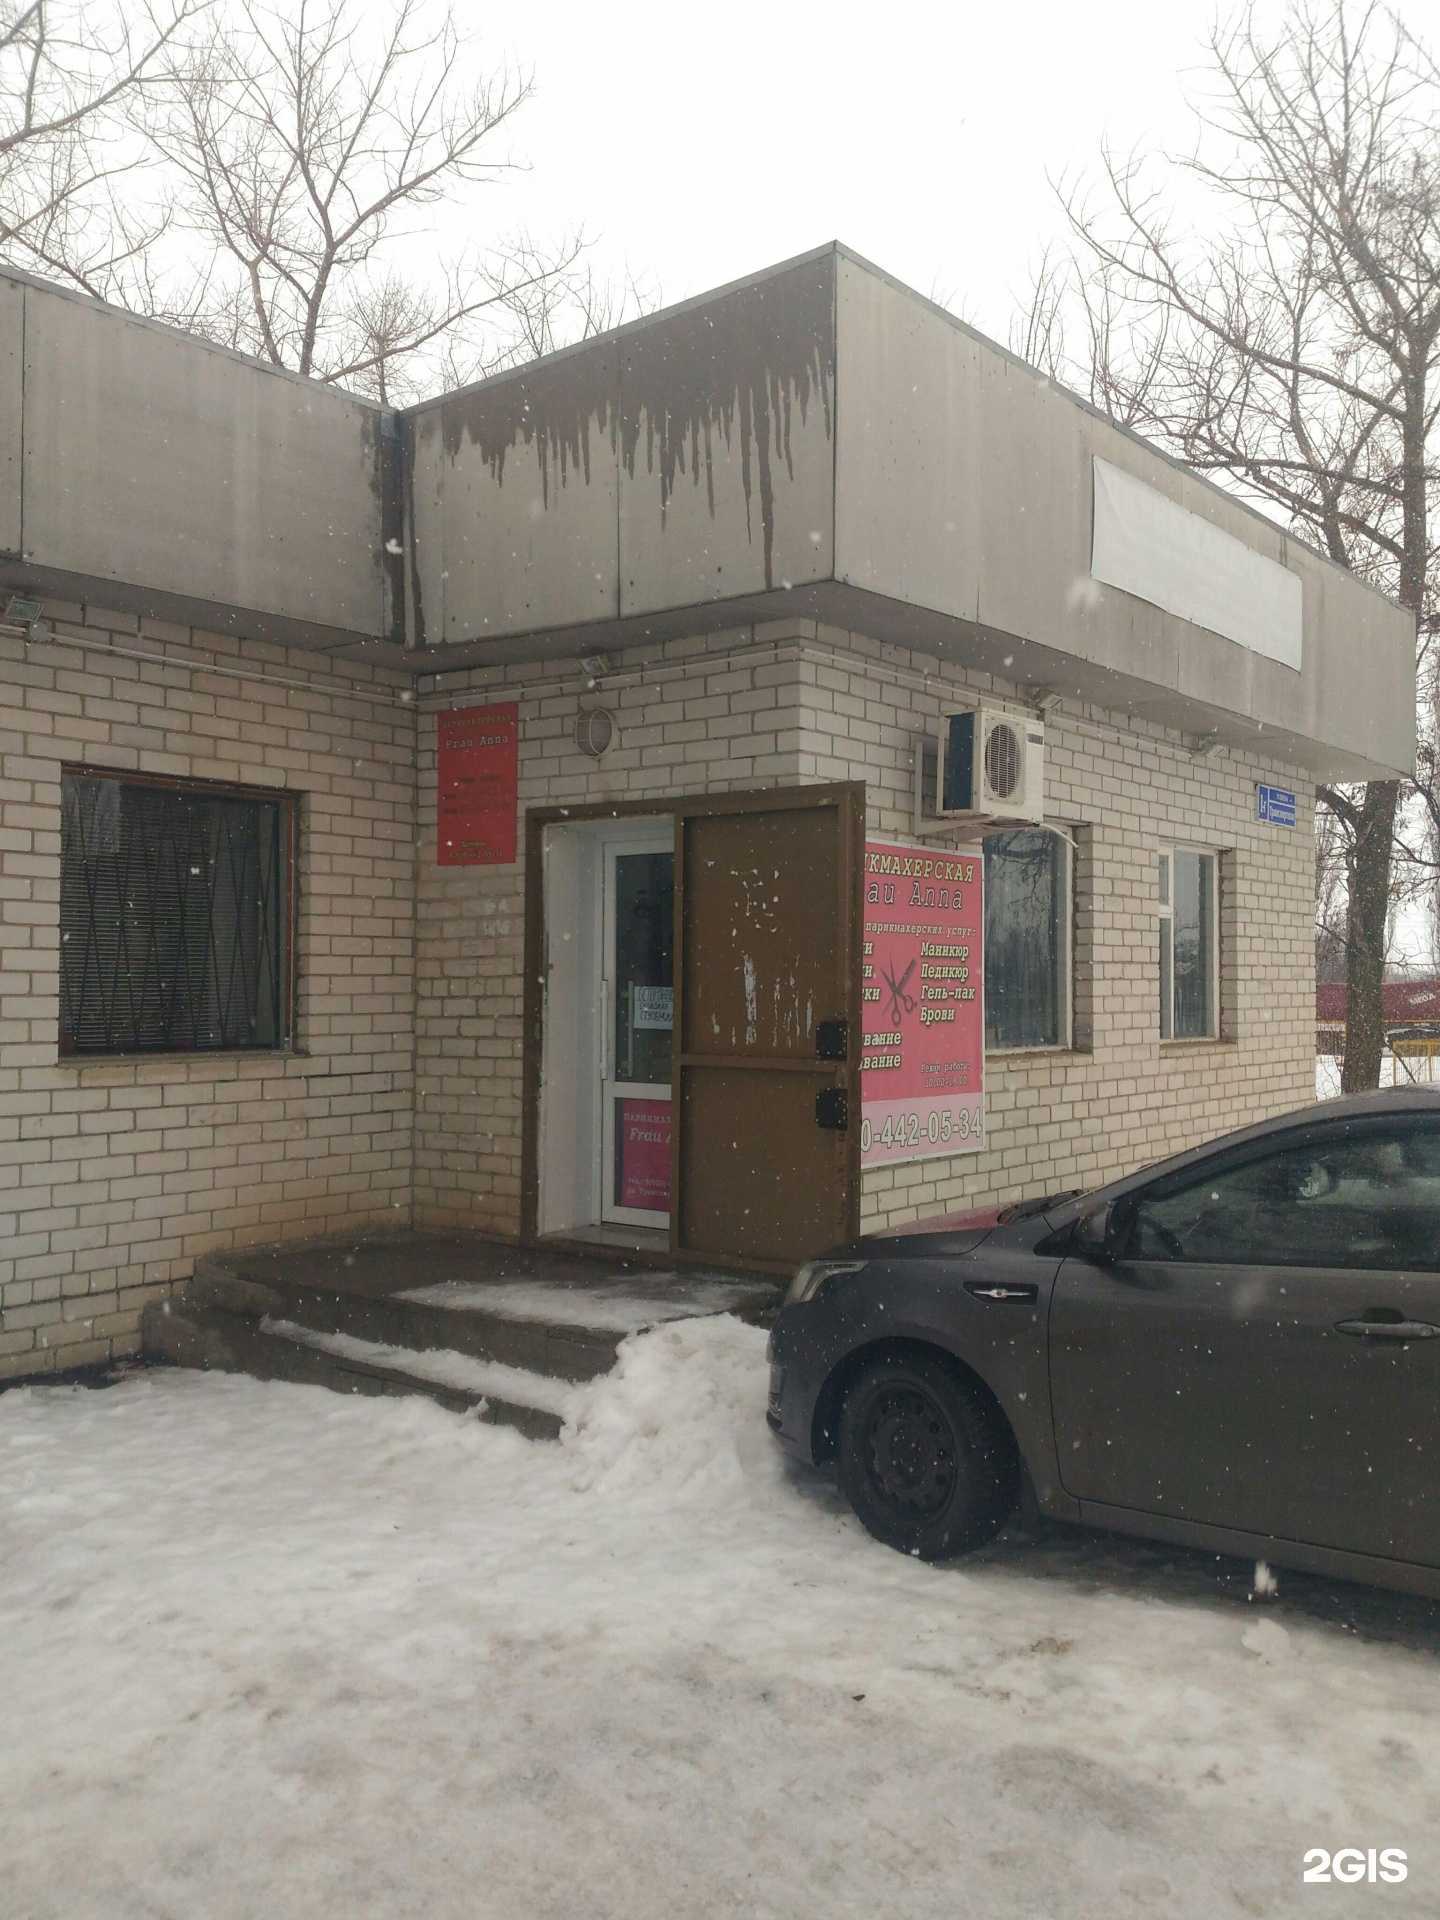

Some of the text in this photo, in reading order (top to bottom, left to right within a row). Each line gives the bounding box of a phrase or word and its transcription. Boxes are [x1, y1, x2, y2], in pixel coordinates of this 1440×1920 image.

[909, 881, 963, 910] Anna
[920, 941, 969, 962] Маникюр
[920, 963, 969, 982] Педикюр
[920, 985, 976, 1001] Гель-лак
[920, 1006, 955, 1025] Брови
